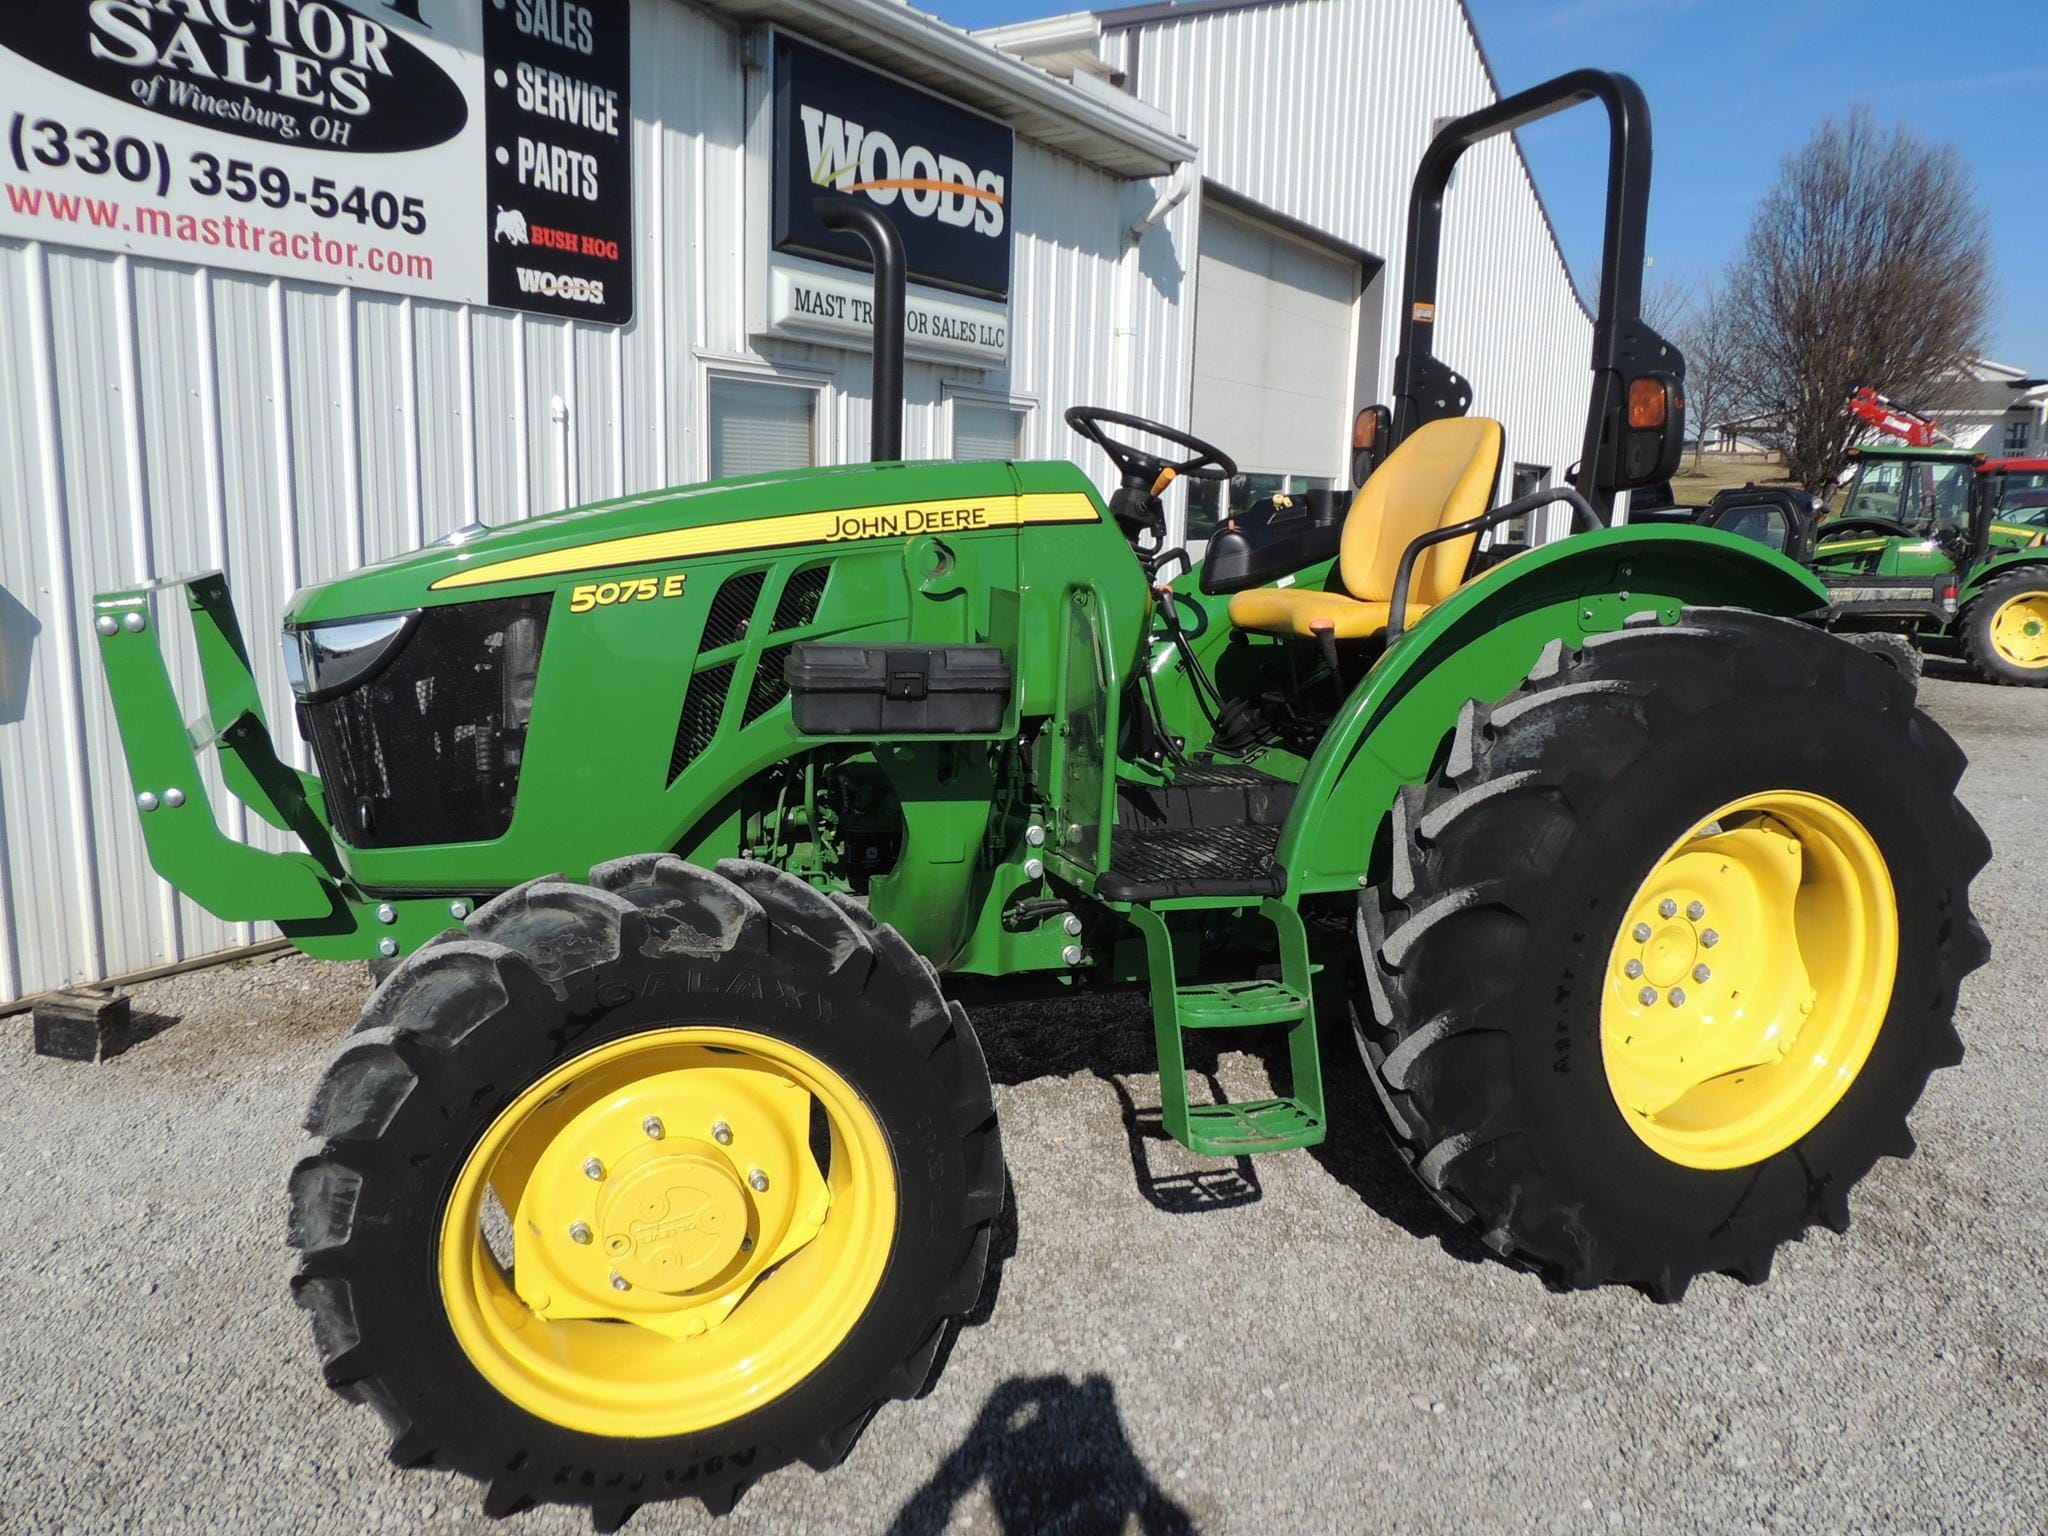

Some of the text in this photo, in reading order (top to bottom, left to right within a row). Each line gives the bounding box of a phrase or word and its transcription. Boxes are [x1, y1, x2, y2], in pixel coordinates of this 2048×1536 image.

[89, 0, 371, 116] SALES
[515, 0, 593, 54] SALES
[131, 74, 352, 147] of Winesburg, OH
[516, 61, 619, 137] SERVICE
[8, 110, 428, 235] (330) 359-5405
[517, 136, 599, 201] PARTS
[800, 103, 1005, 238] WOODS
[5, 182, 434, 281] www.masttractor.com
[531, 224, 619, 261] BUSH HOG
[516, 266, 605, 305] WOODS
[794, 287, 1005, 349] MAST TROR SALES LLC
[826, 508, 988, 540] JOHN DEERE
